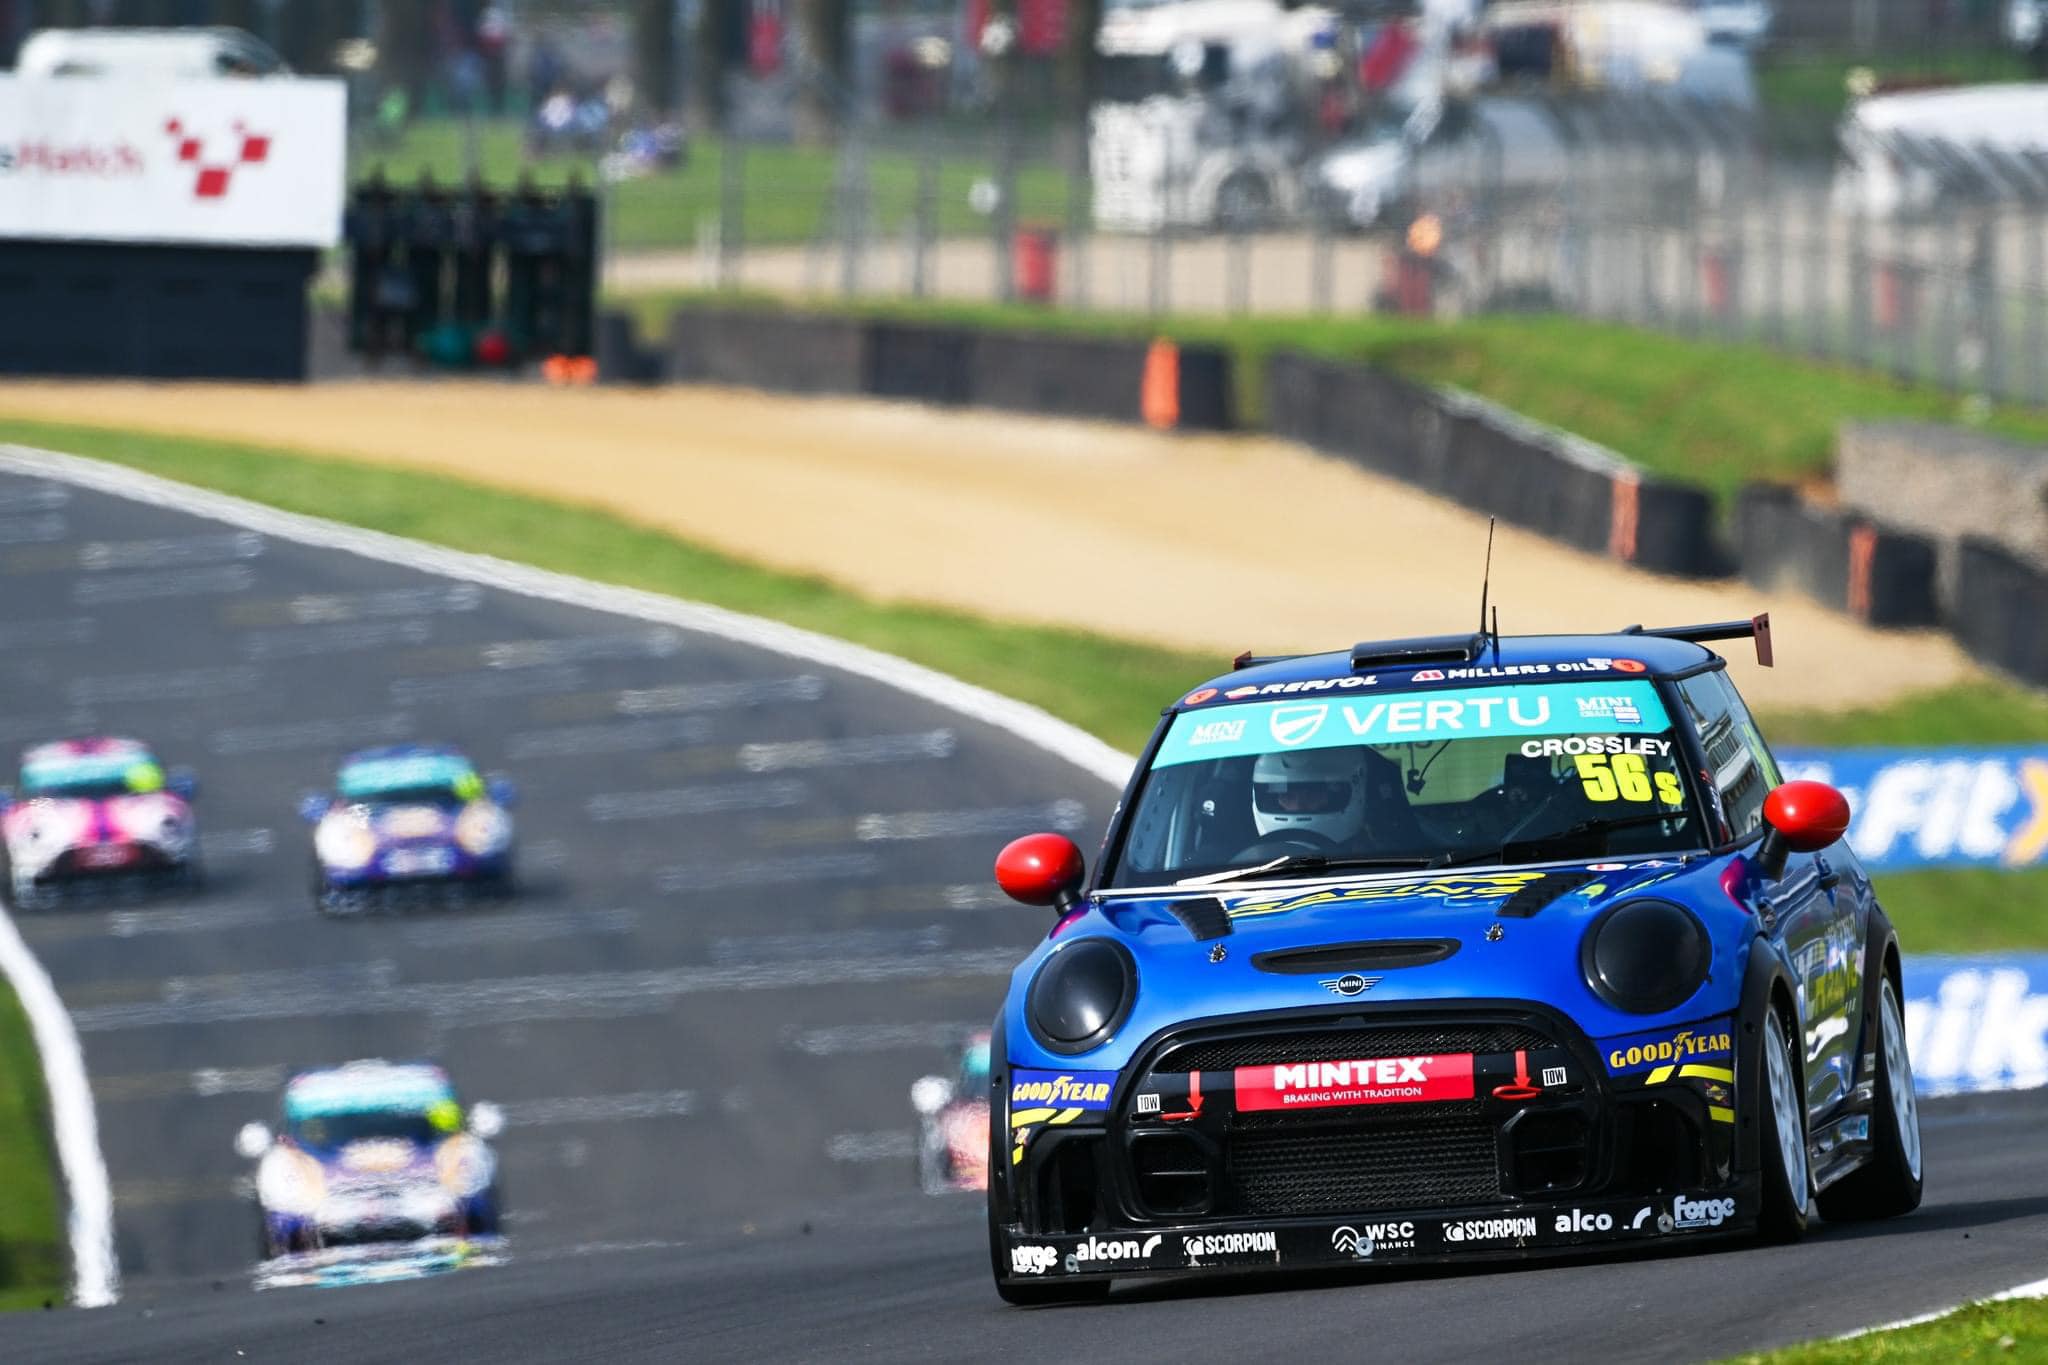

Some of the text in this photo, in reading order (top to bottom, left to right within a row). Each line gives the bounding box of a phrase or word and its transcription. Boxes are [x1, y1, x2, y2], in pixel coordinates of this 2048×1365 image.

[1448, 665, 1550, 679] MILLERS
[1260, 675, 1378, 694] REPSOL
[1342, 695, 1550, 735] VERTU
[1521, 737, 1672, 758] CROSSLEY
[1574, 754, 1653, 802] 56
[1339, 978, 1363, 991] MINI
[1609, 1031, 1731, 1068] GOODYEAR
[1274, 1057, 1427, 1090] MINTEX
[1545, 1069, 1564, 1084] TOW
[1012, 1075, 1111, 1105] GOODYEAR
[1283, 1087, 1423, 1104] BRAKING WITH TRADITION
[1139, 1095, 1159, 1111] TOW
[1555, 1209, 1630, 1232] alco
[1674, 1195, 1736, 1226] forge
[1365, 1221, 1415, 1241] WSC
[1466, 1217, 1537, 1240] SCORPION
[1076, 1236, 1140, 1261] alcon
[1205, 1231, 1276, 1254] SCORPION
[1375, 1240, 1415, 1250] INANCE
